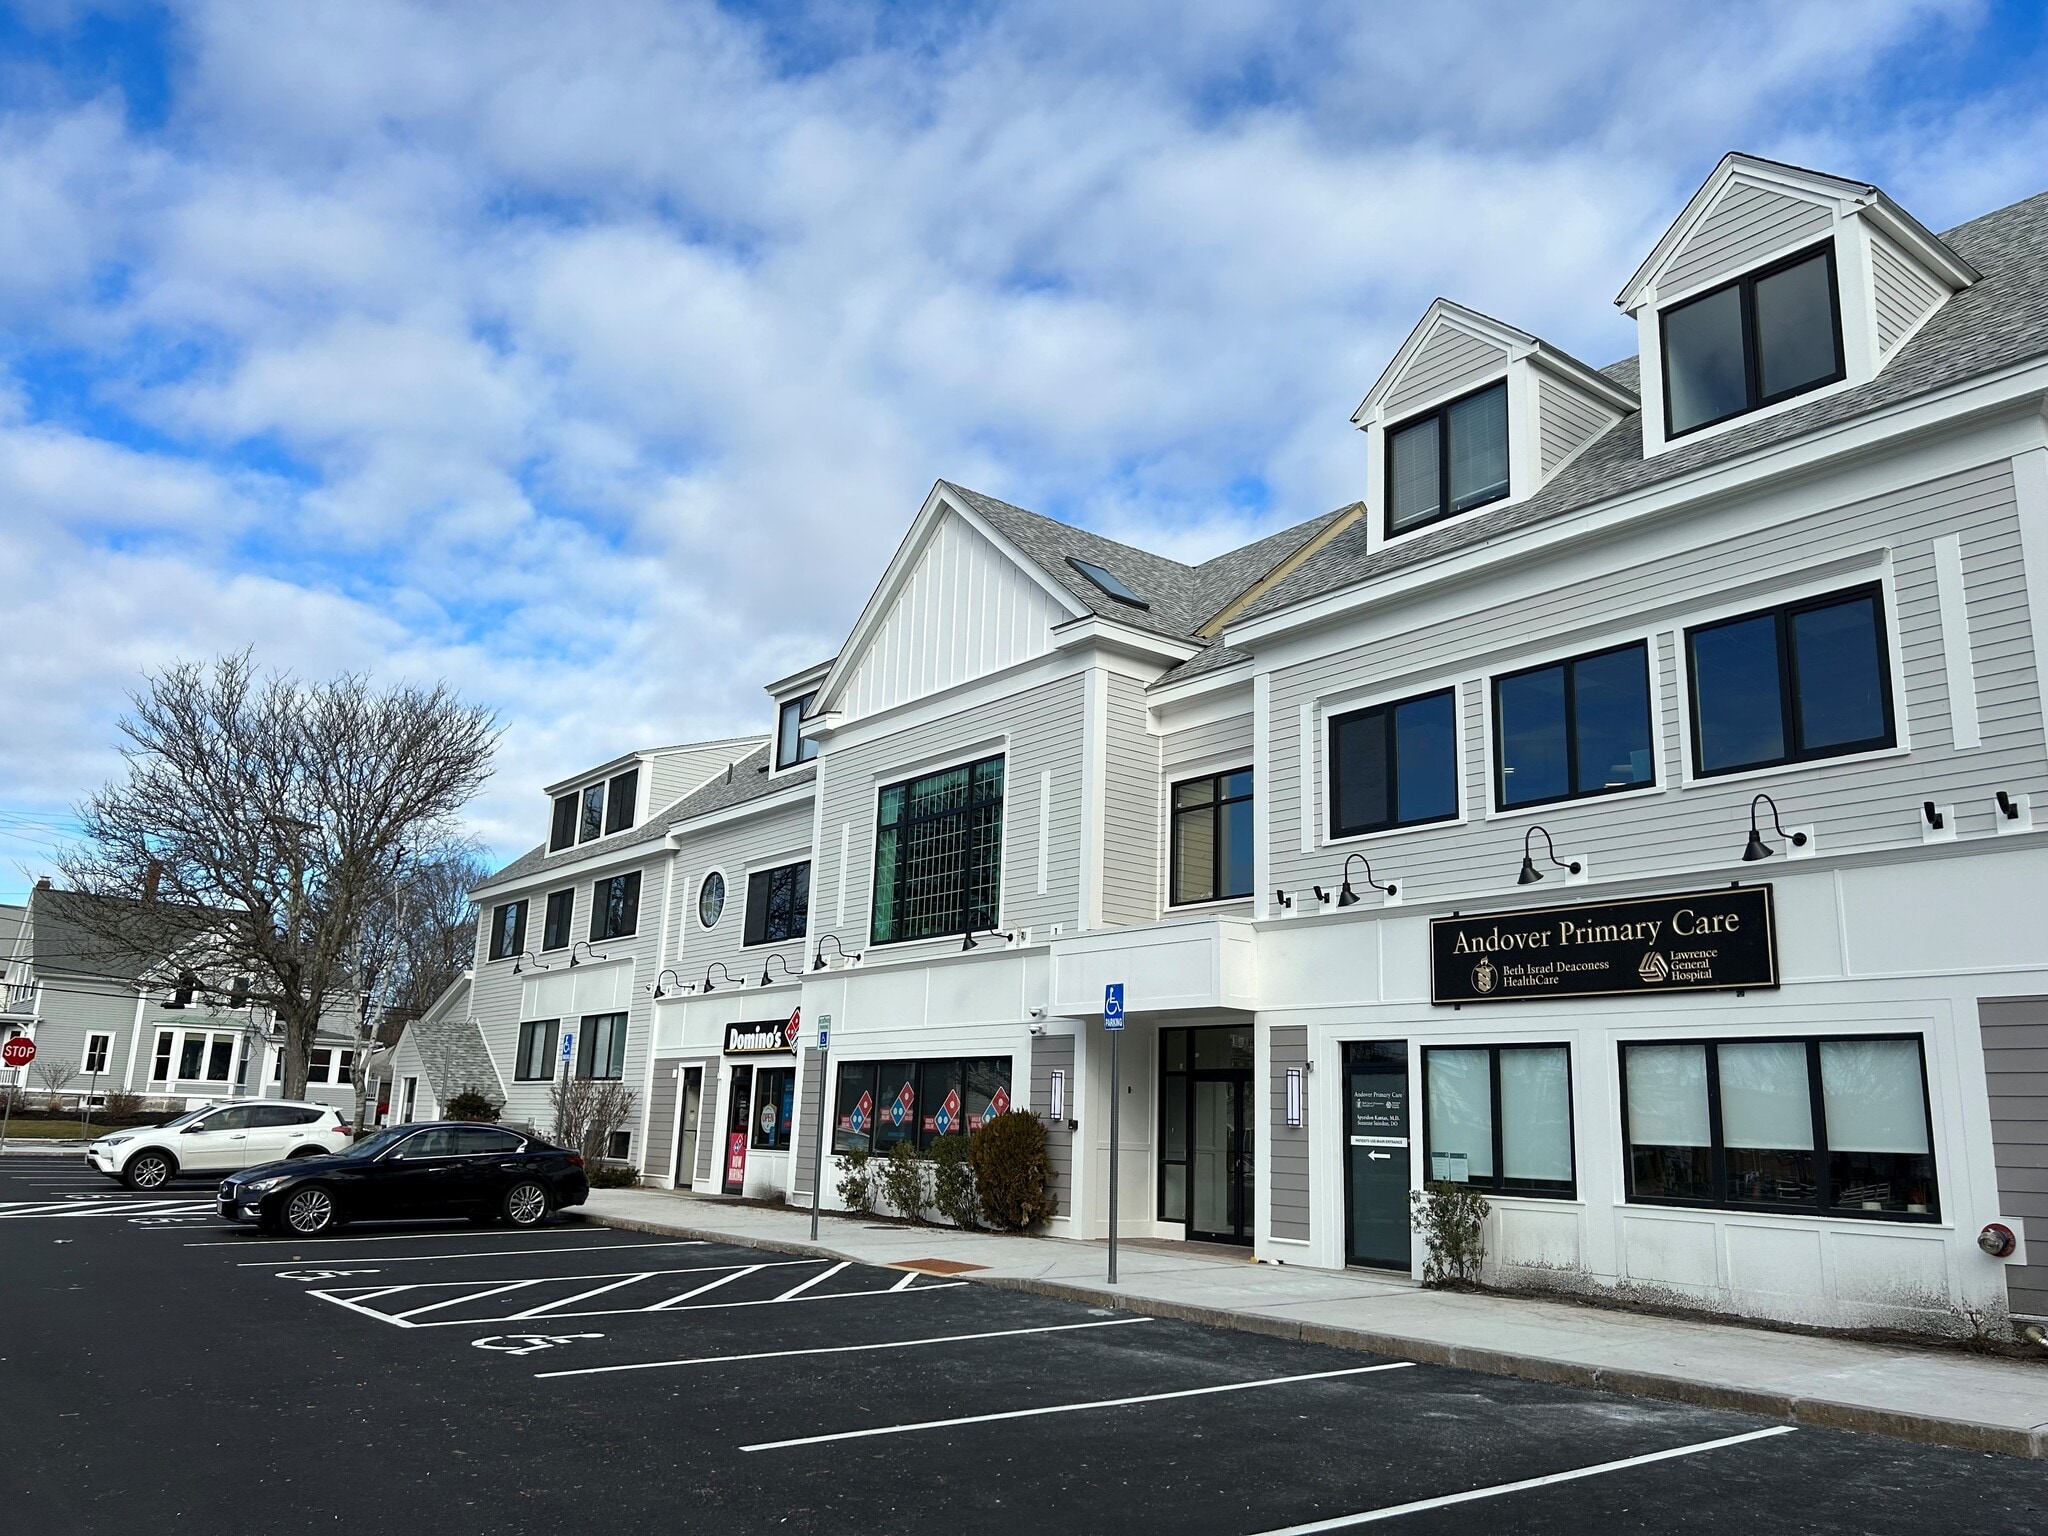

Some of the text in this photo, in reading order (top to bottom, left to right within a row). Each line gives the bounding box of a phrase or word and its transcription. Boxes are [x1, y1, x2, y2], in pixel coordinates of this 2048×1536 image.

[1452, 909, 1740, 955] Andover Primary Care
[1670, 949, 1719, 960] Lawrence
[1503, 961, 1610, 976] Beth Israel Deaconess
[1670, 959, 1710, 971] General
[1503, 974, 1560, 988] HealthCare
[1671, 969, 1713, 982] Hospital
[1105, 1018, 1123, 1027] PARKING
[729, 1025, 782, 1050] Domino's
[4, 1045, 35, 1058] STOP
[1373, 1091, 1391, 1099] Primary
[762, 1112, 775, 1123] OPEN
